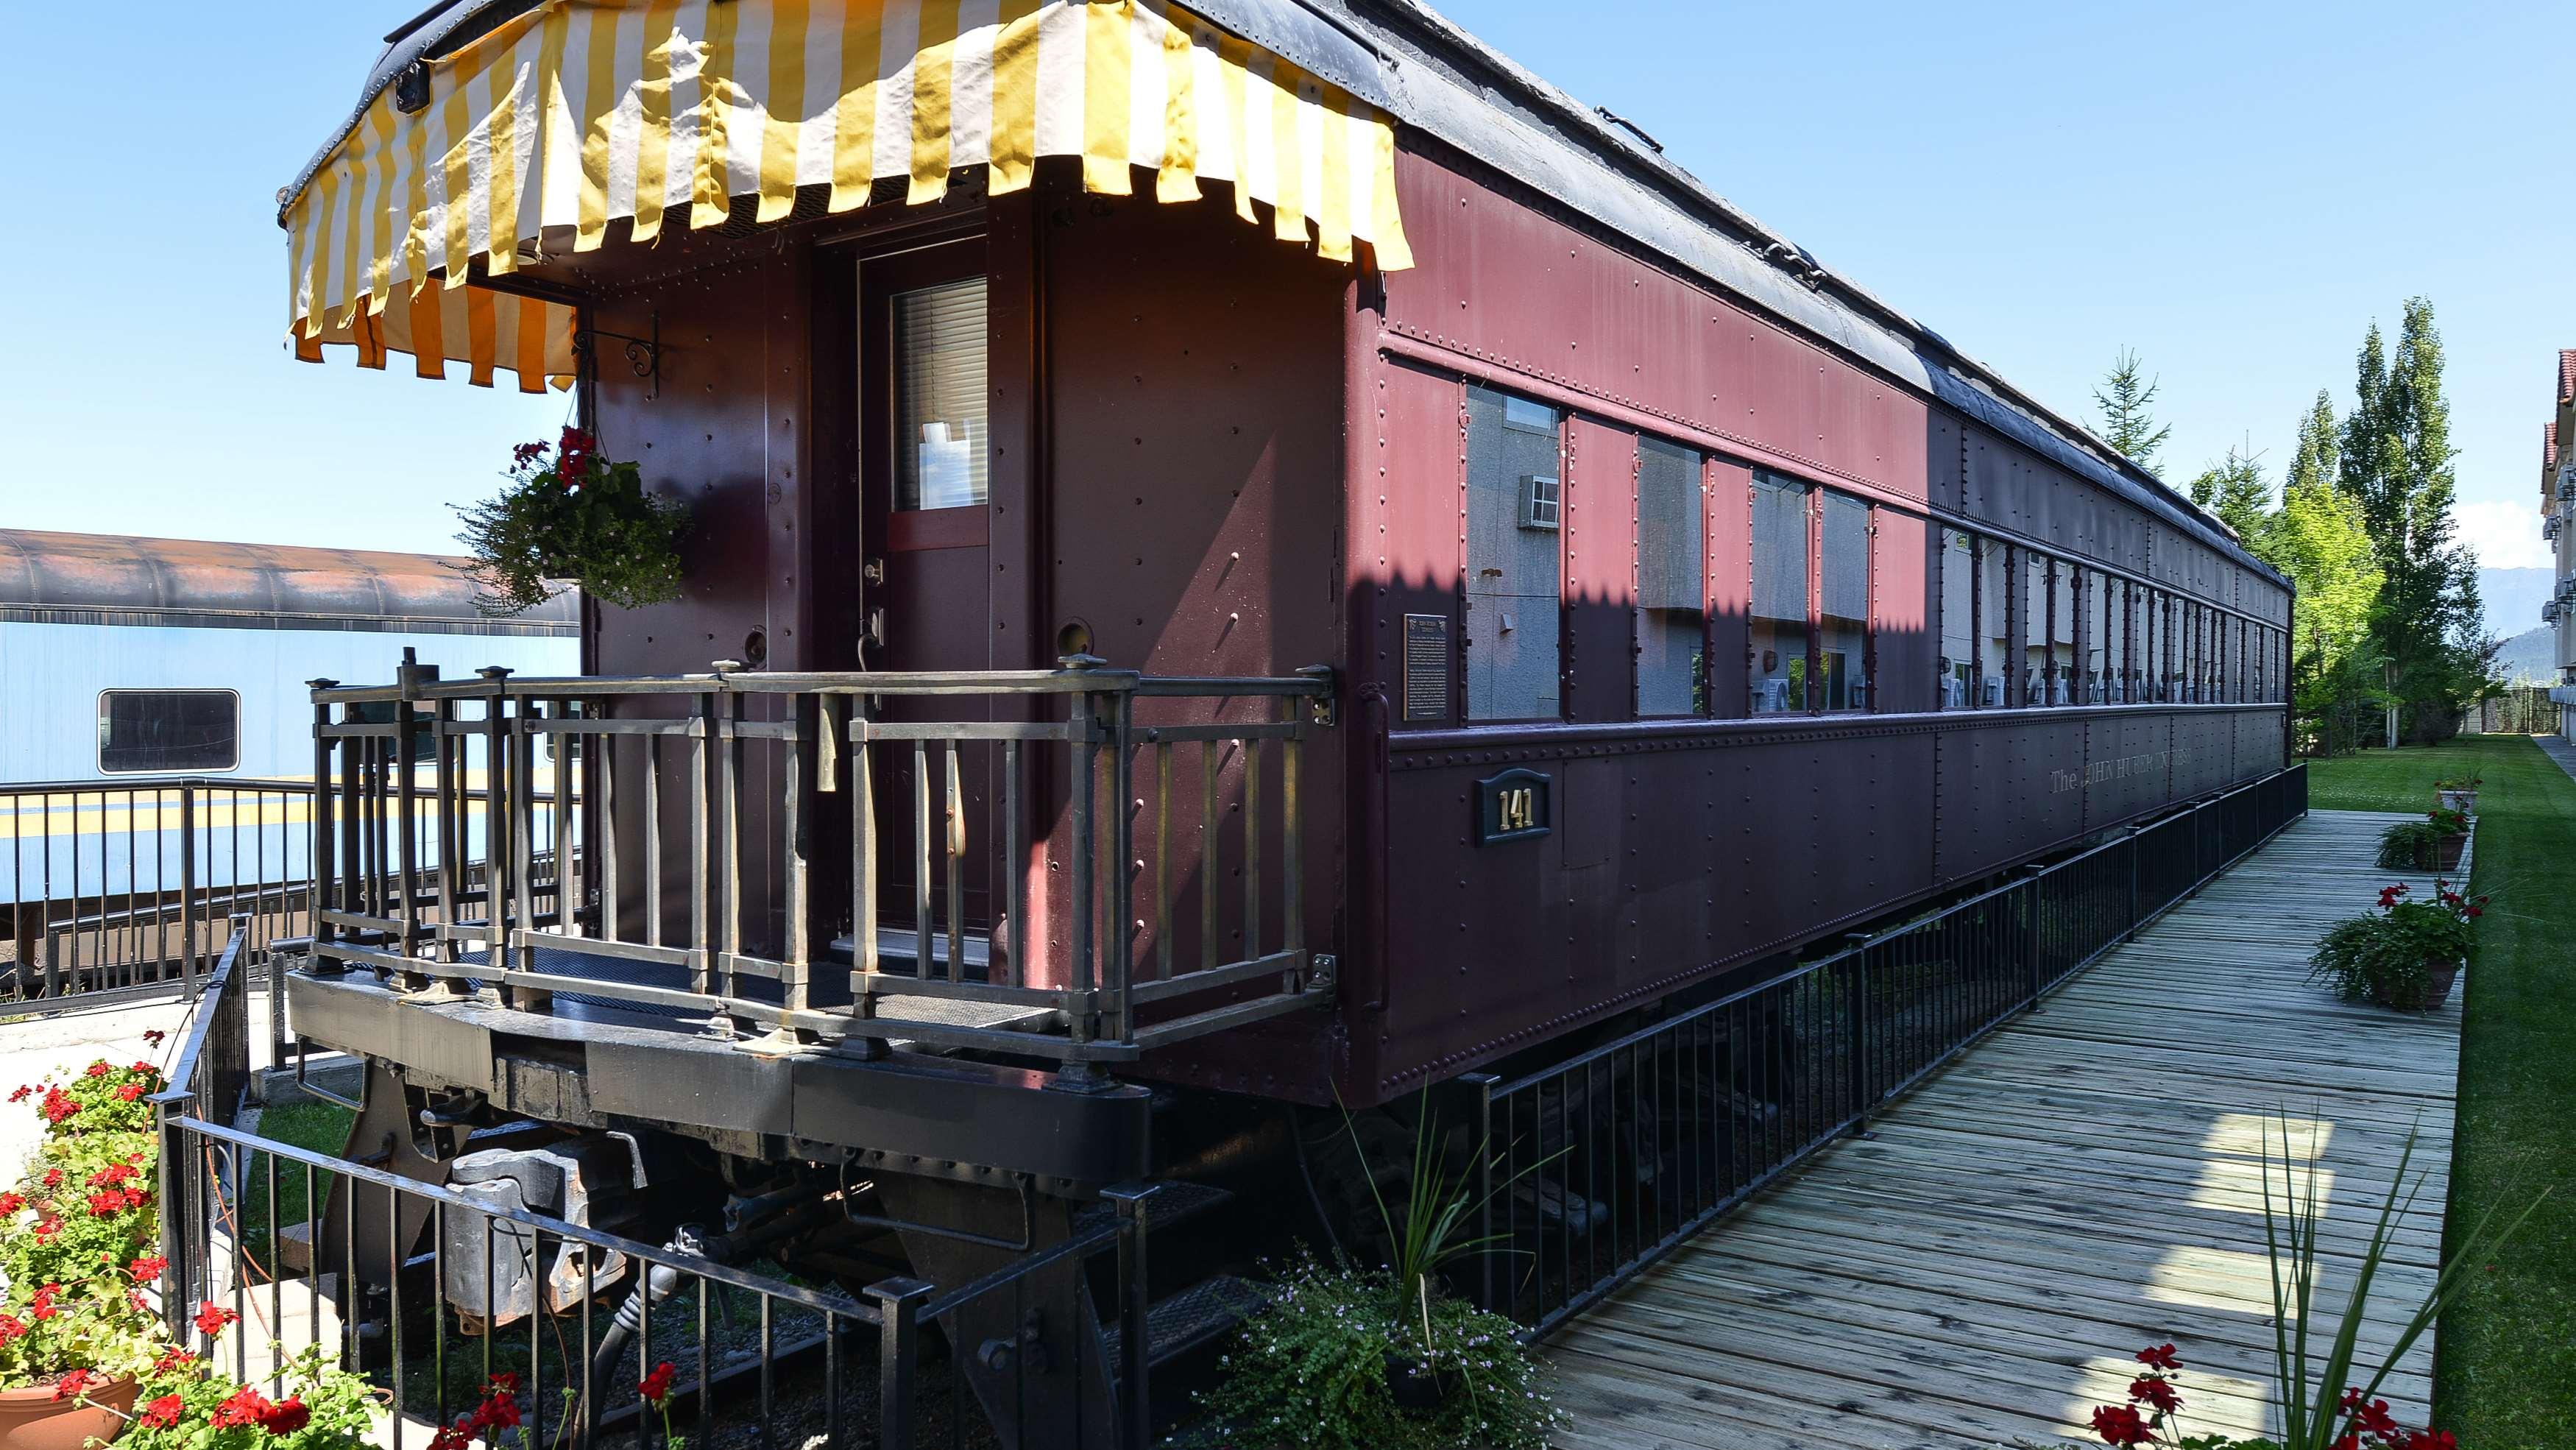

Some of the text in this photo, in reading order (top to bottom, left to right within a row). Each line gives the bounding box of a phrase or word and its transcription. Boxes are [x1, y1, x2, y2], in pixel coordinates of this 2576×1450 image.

[2050, 769, 2077, 793] The
[2081, 760, 2115, 787] JOHN
[1499, 788, 1534, 831] 141
